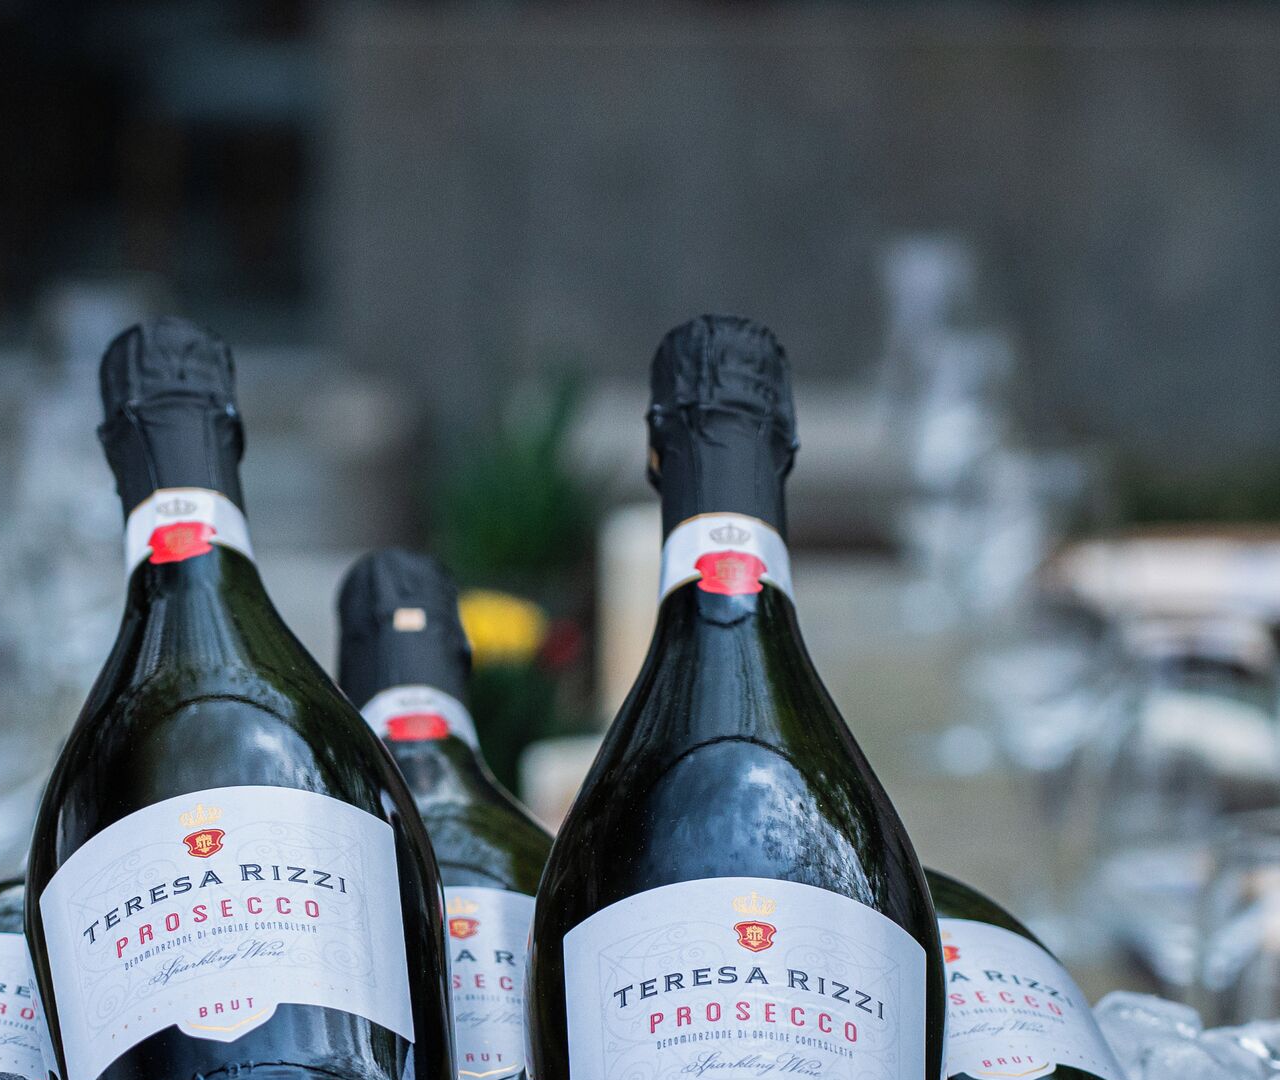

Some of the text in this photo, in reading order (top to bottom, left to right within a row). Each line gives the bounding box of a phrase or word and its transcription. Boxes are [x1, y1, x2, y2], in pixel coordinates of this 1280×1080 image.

[83, 863, 348, 945] TERESA RIZZI
[116, 896, 320, 959] PROSECCO
[124, 920, 318, 971] DENOMINAZIONE DI ORIGINE CONTROLLATA
[148, 938, 285, 986] Sparkling Wine
[198, 997, 255, 1019] BRUT
[613, 966, 885, 1021] TERESA RIZZI
[948, 990, 1063, 1017] SECCO
[650, 1001, 858, 1043] PROSECCO
[465, 1052, 503, 1063] RUT
[656, 1029, 854, 1059] DENOMINAZIONE DI ORIGINE CONTROLLATA
[982, 1055, 1034, 1068] BRUT
[680, 1050, 823, 1078] Sparkling Wine
